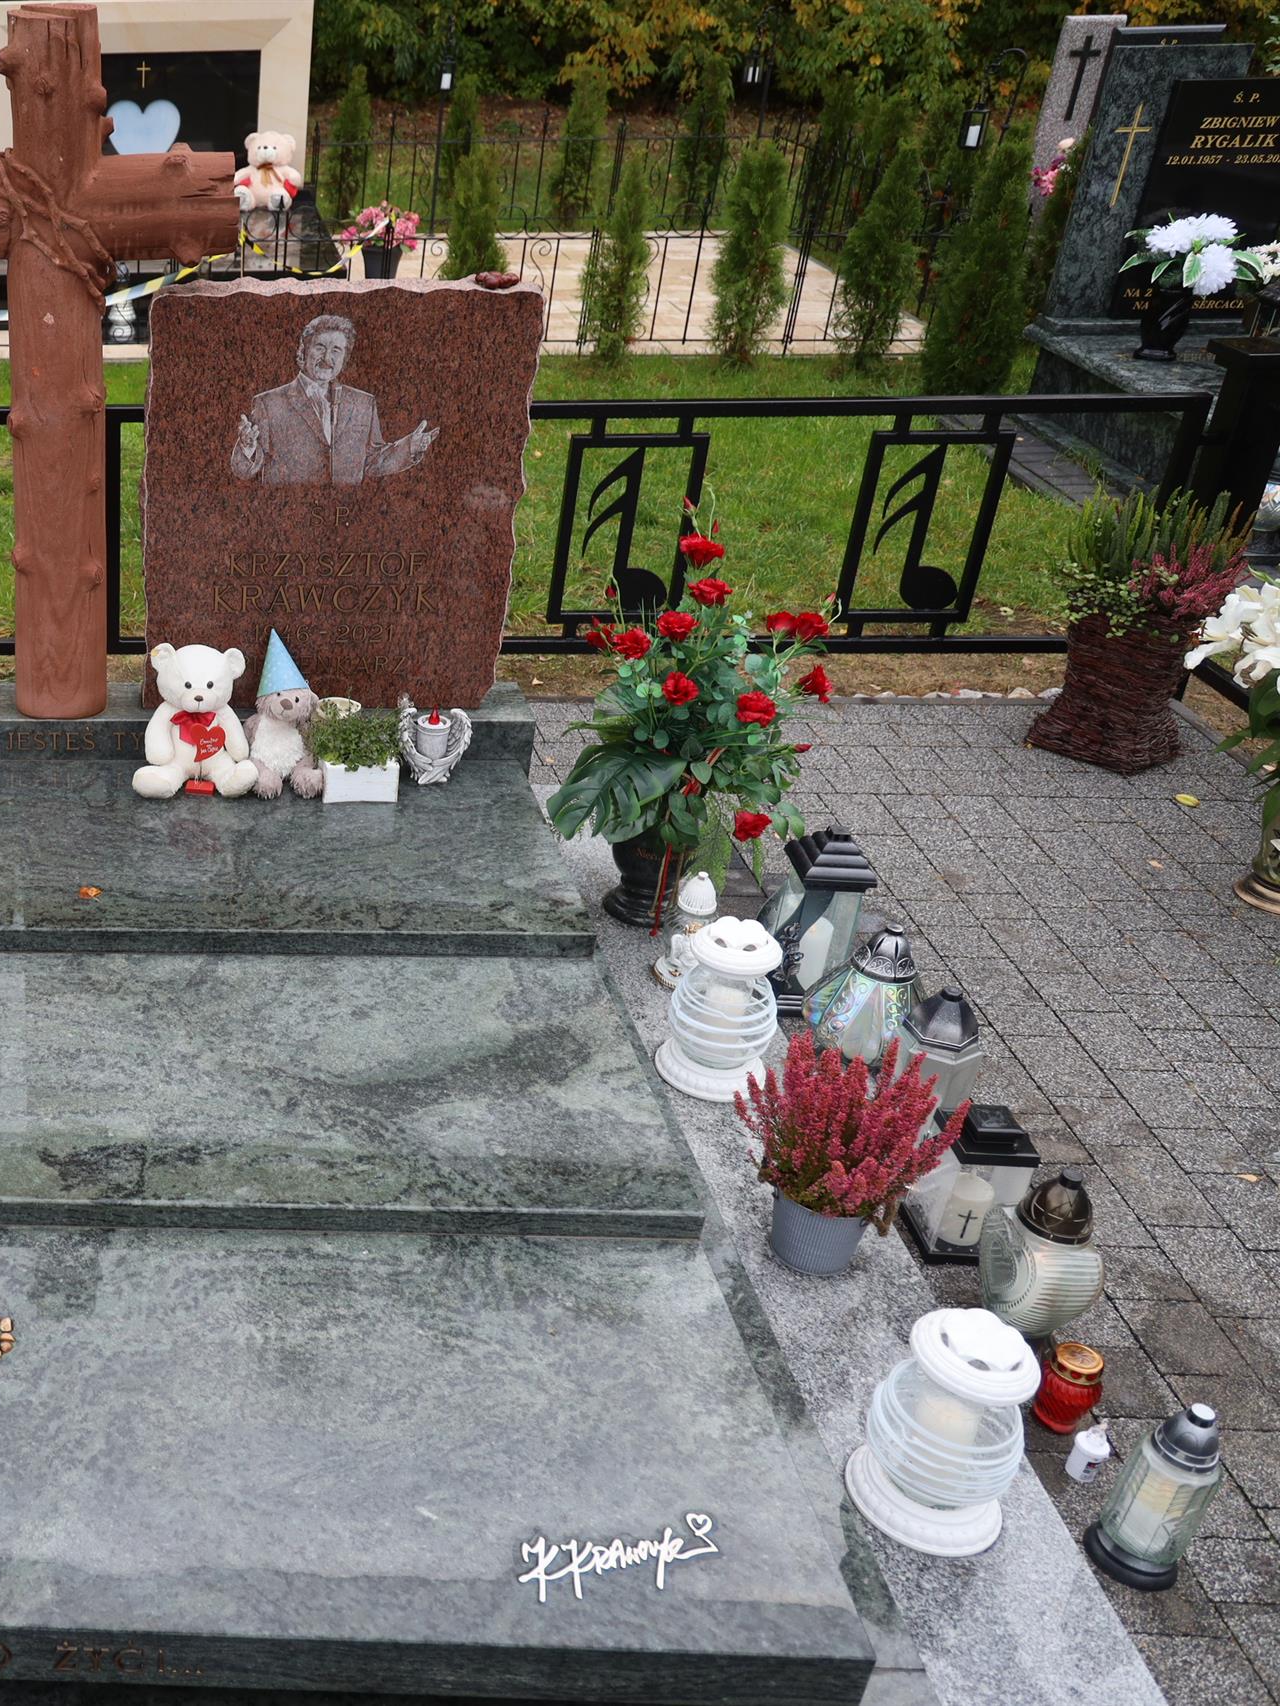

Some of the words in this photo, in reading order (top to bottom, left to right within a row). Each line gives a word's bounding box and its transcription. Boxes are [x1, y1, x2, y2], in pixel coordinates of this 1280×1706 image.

[1200, 115, 1280, 129] ZBIGNIEW
[1189, 133, 1280, 149] RYGALIK
[1166, 154, 1223, 165] 12.01.1957
[228, 551, 427, 578] KRZYSZTOF
[212, 584, 437, 613] KRAWCZYK
[335, 623, 395, 643] 2021
[7, 726, 96, 752] JESTEŚ
[112, 732, 145, 751] TY
